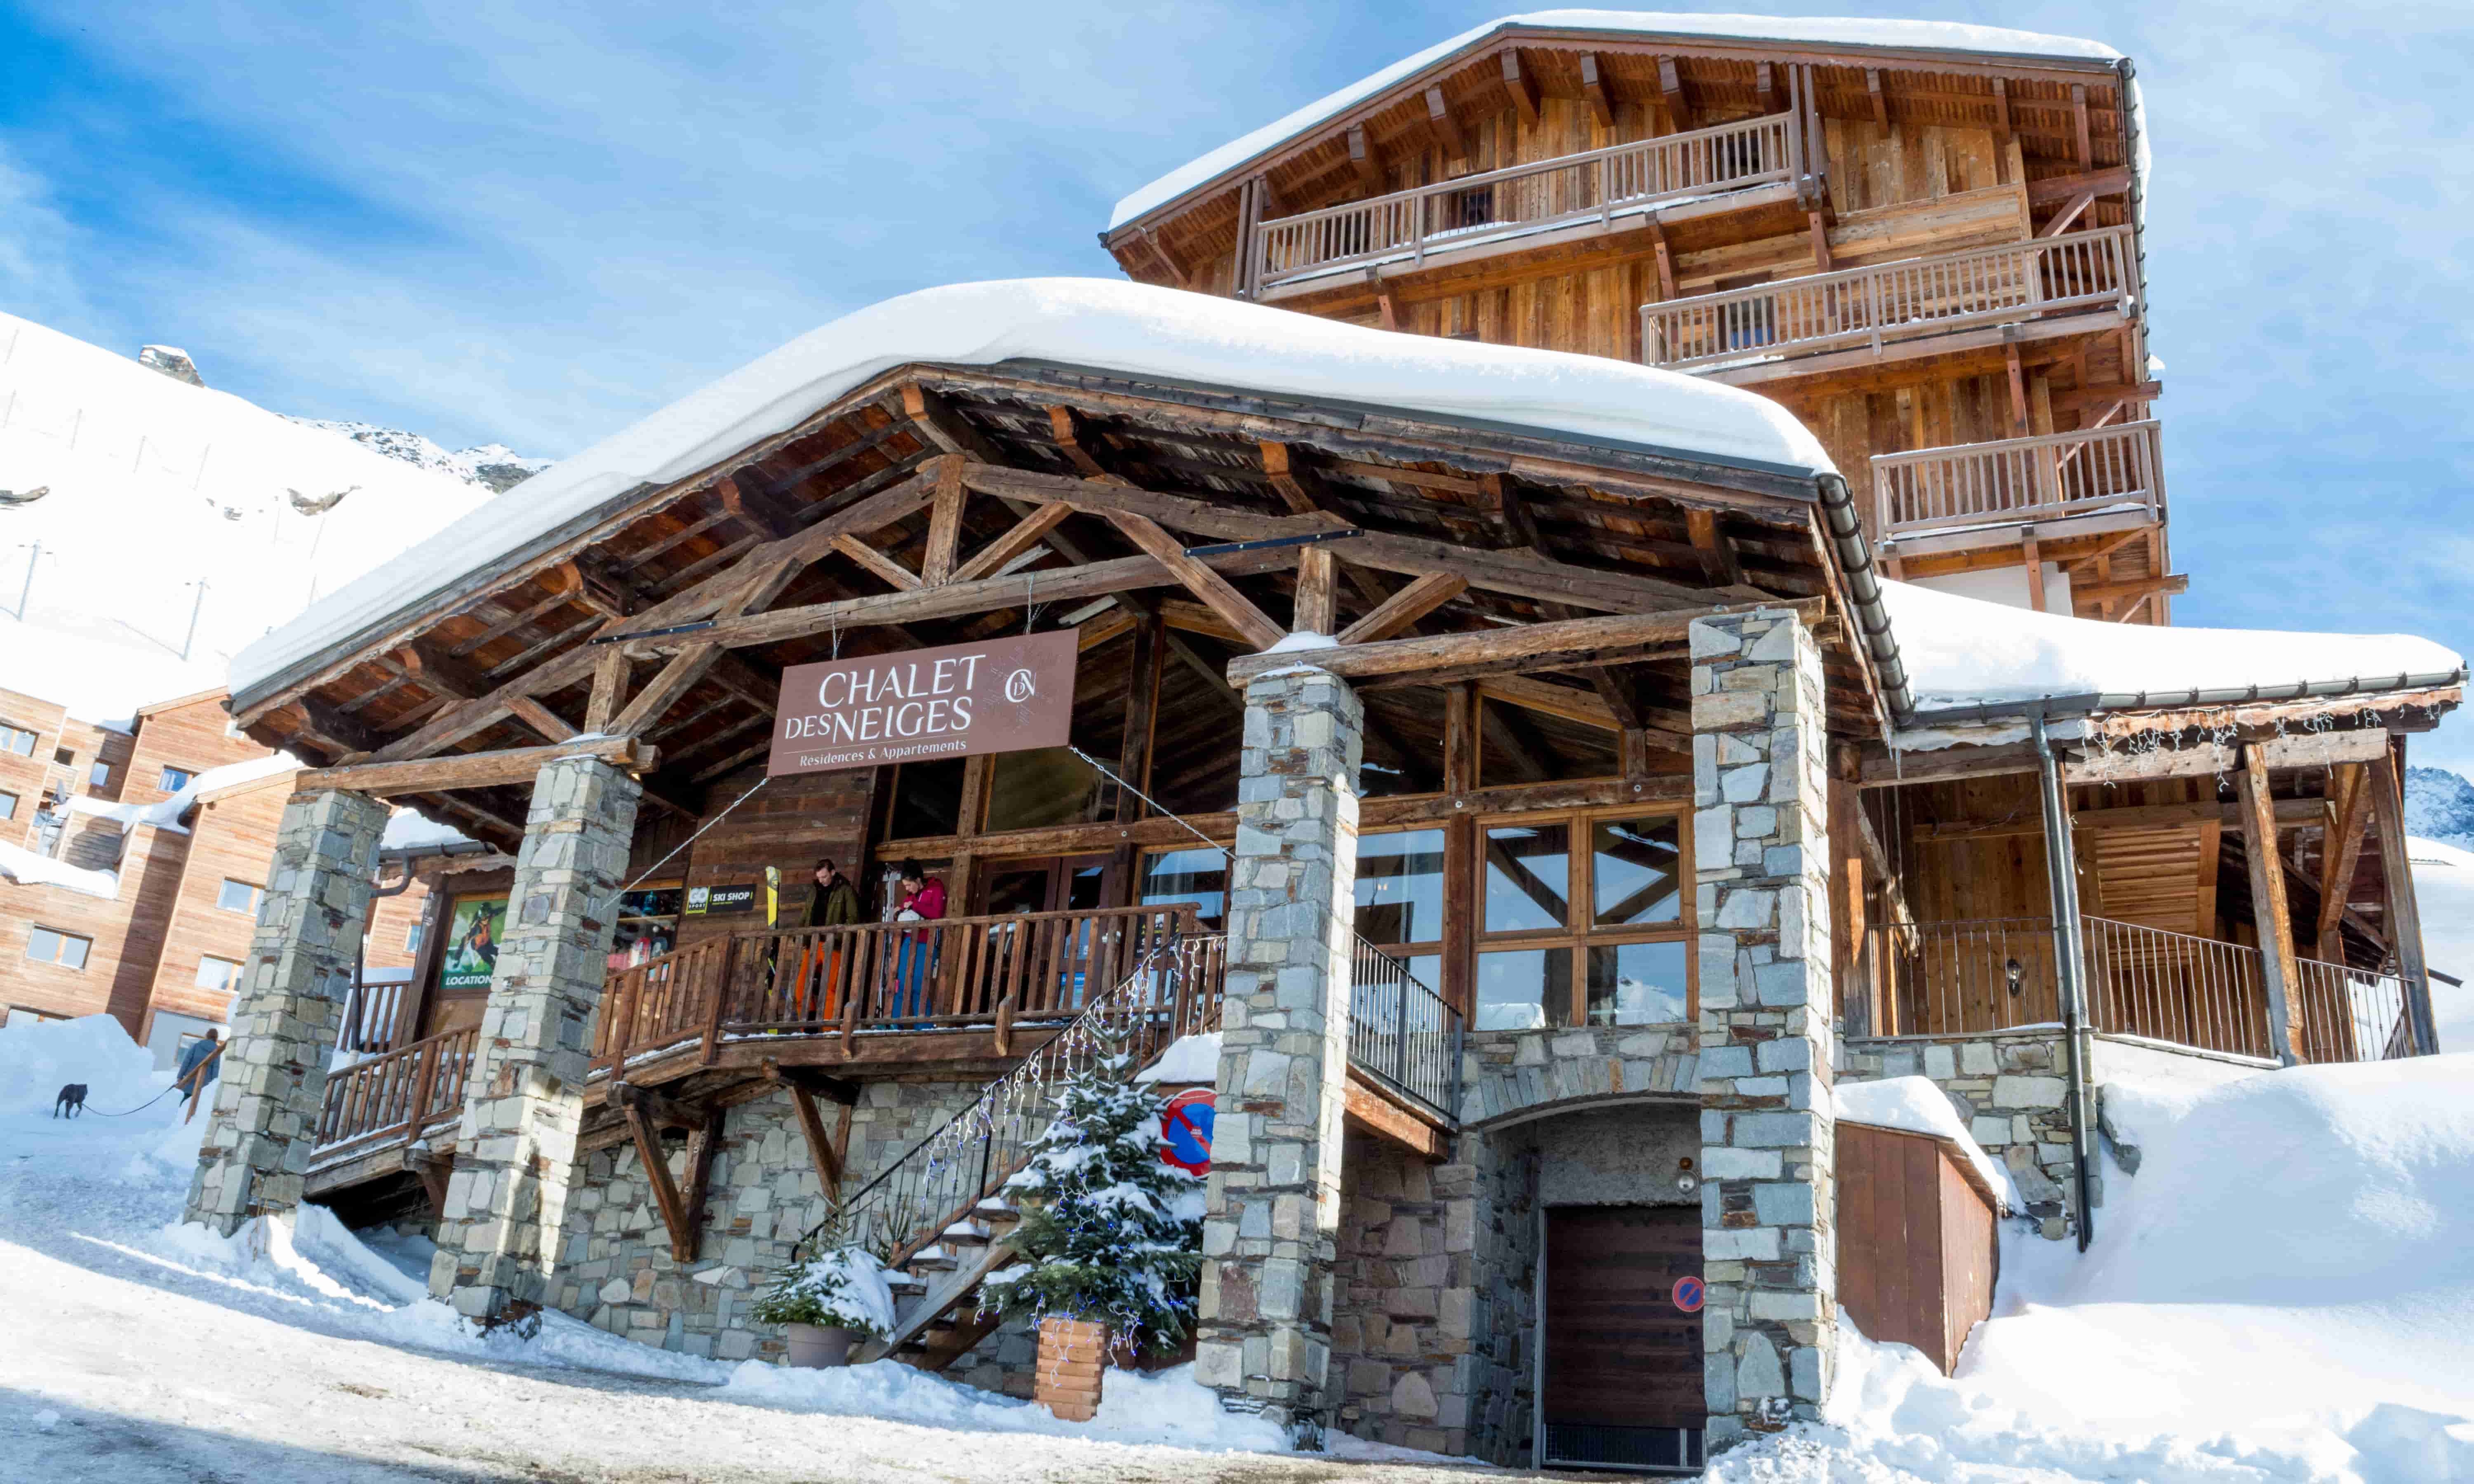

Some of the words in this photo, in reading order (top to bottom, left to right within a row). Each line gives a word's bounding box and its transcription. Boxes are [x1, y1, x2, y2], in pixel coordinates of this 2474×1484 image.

[819, 654, 986, 708] CHALET
[785, 714, 832, 739] DES
[833, 696, 972, 743] NEIGES
[868, 748, 876, 760] &
[880, 739, 967, 760] Appartements
[689, 887, 708, 904] GO
[712, 893, 727, 902] SKI
[727, 891, 750, 901] SHOP
